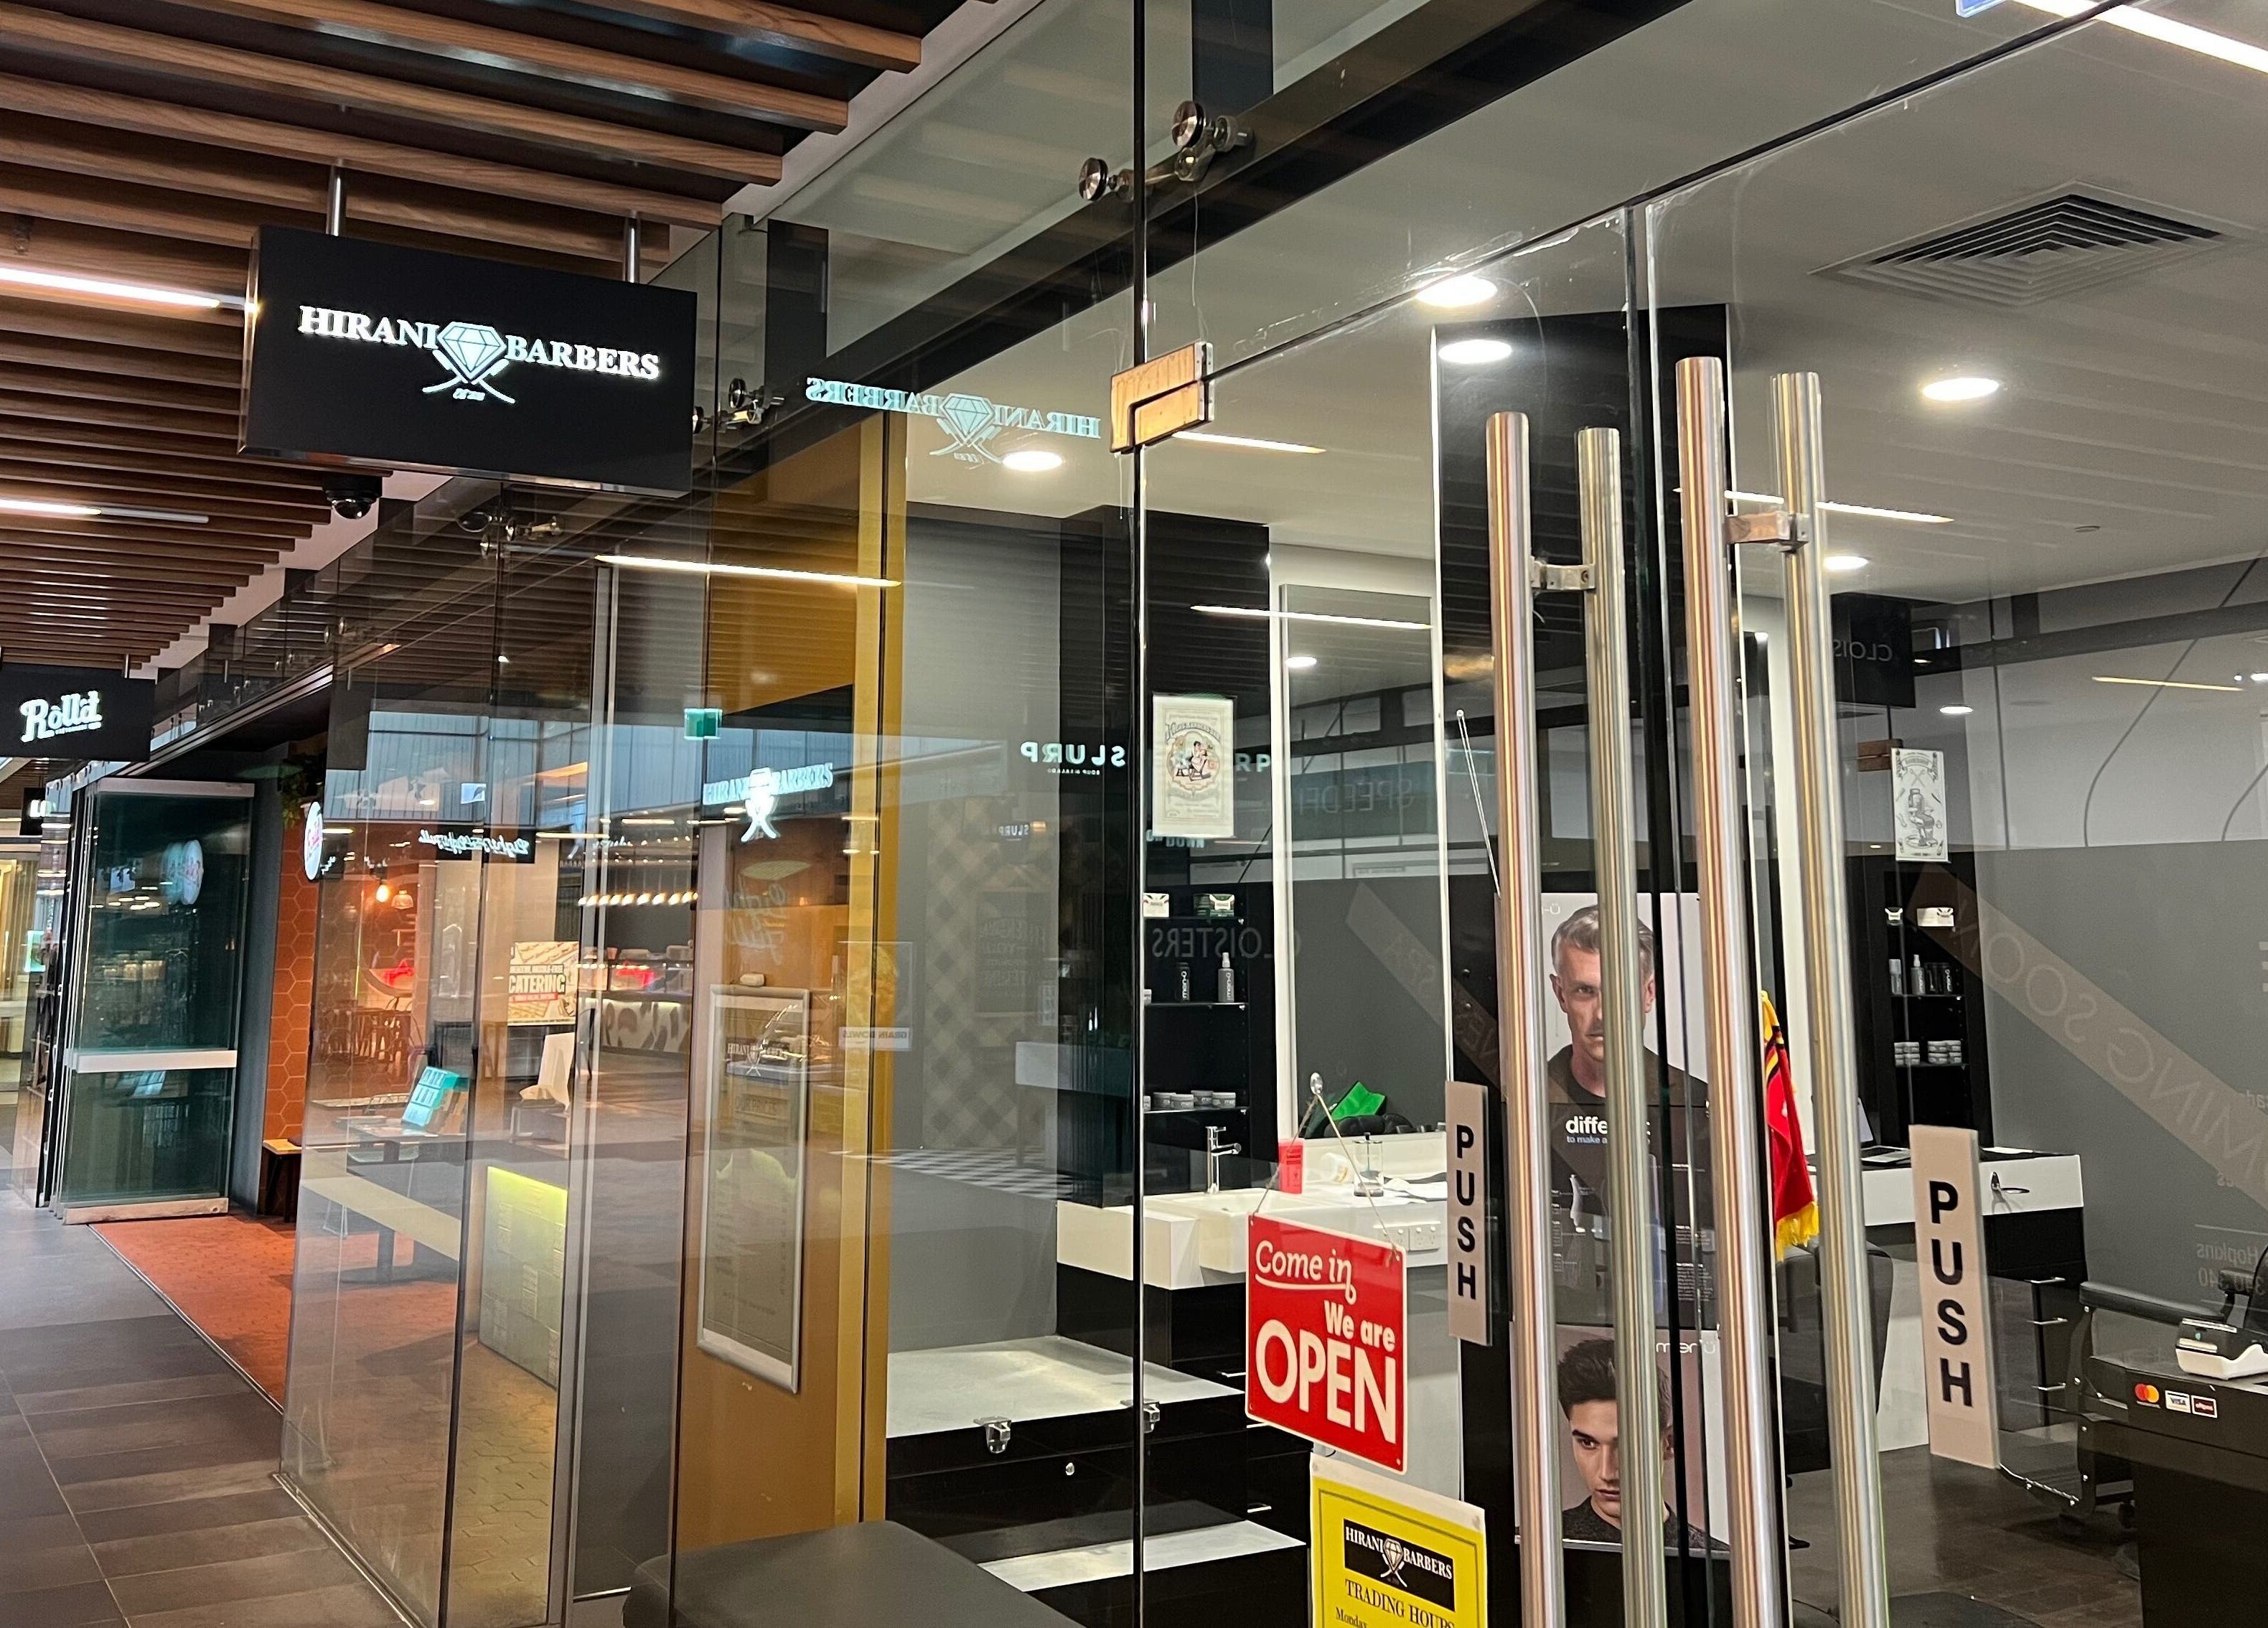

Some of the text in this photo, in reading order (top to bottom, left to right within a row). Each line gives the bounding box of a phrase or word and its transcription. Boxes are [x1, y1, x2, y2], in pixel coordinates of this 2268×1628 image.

[298, 305, 660, 380] HIRANI BARBERS
[508, 973, 566, 994] CATERING
[1577, 1135, 1600, 1143] make
[1456, 1124, 1476, 1300] PUSH
[1256, 1240, 1357, 1305] Come in
[1929, 1180, 1974, 1408] PUSH
[1324, 1299, 1396, 1352] We are
[1255, 1319, 1396, 1445] OPEN
[2170, 1397, 2187, 1406] VISA
[1345, 1526, 1453, 1580] HIRANI BARBERS
[1335, 1606, 1367, 1628] Monday
[1345, 1578, 1405, 1619] TRADING
